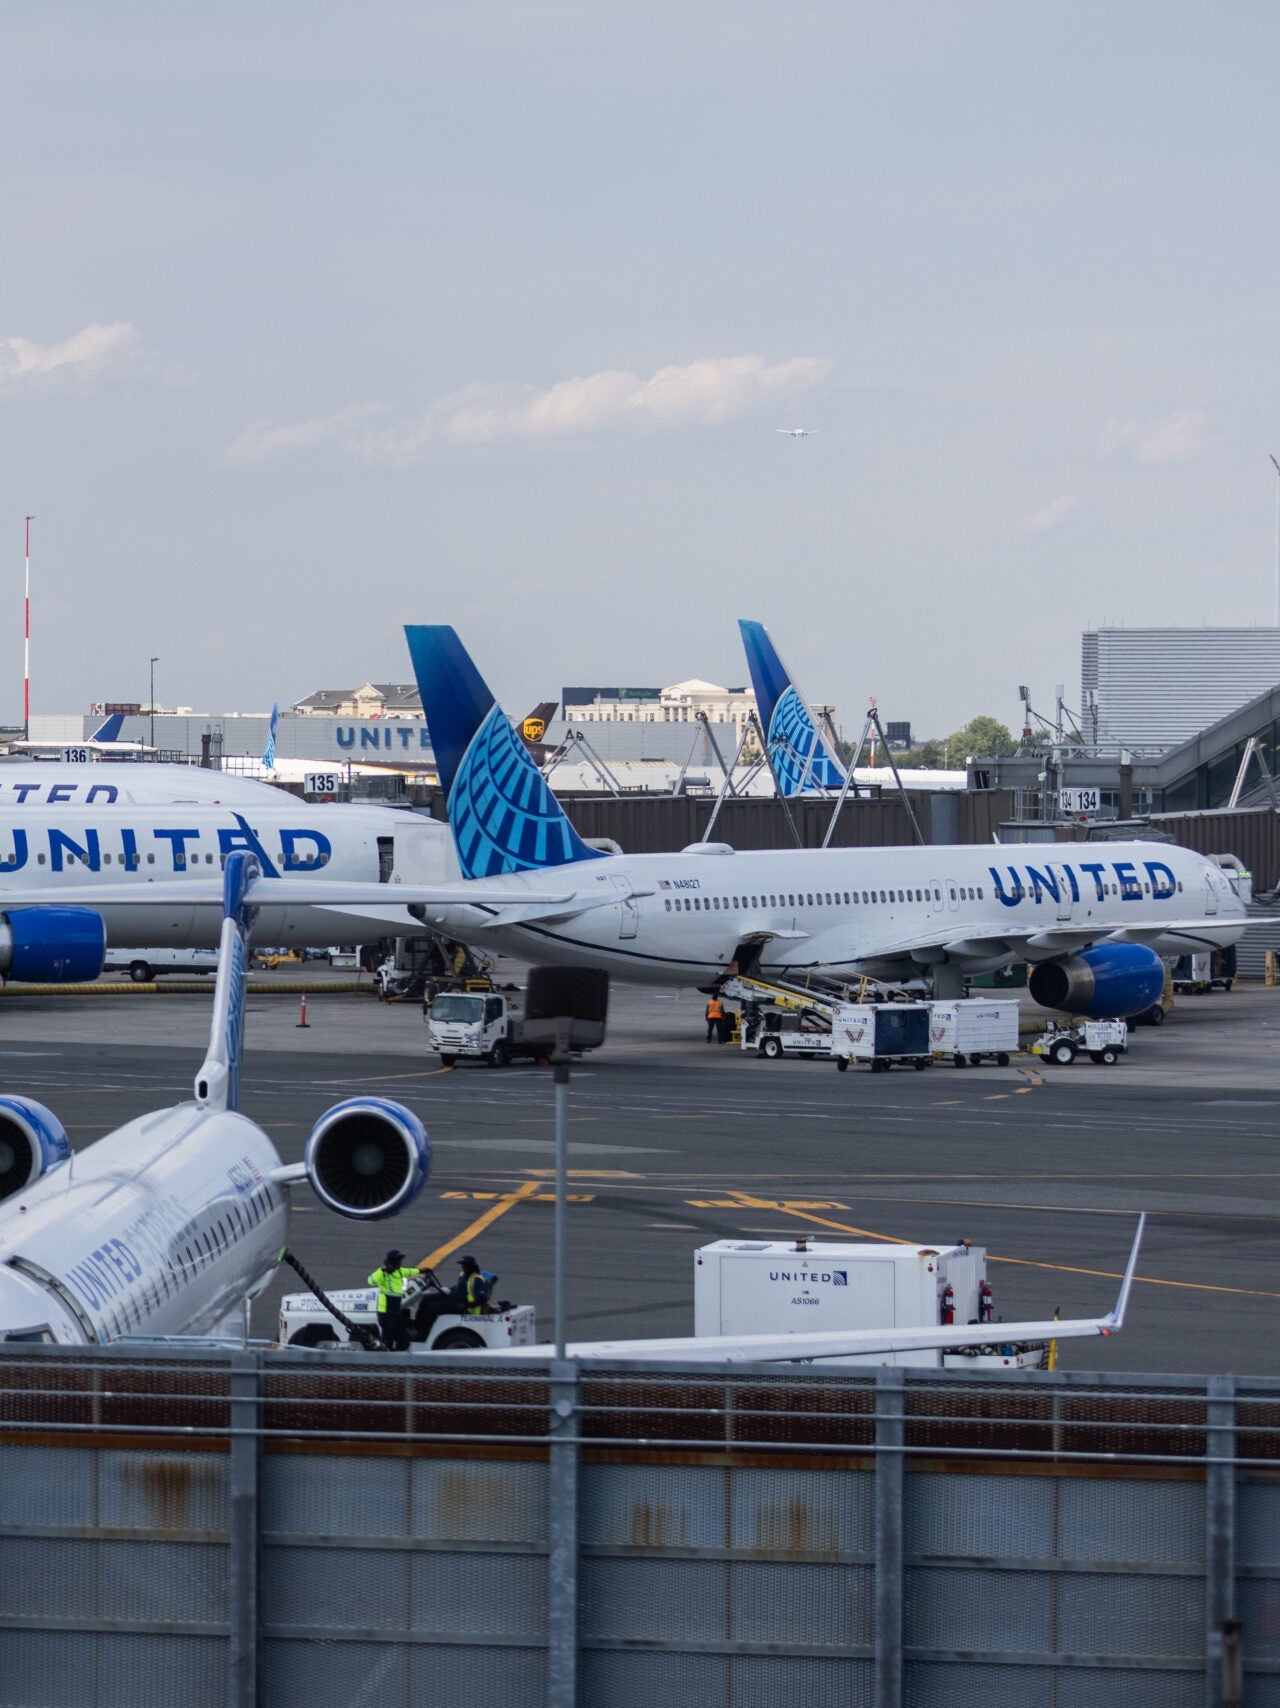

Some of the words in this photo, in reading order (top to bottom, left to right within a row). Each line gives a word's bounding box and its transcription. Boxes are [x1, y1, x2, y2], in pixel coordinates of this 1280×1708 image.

[336, 727, 431, 750] UNITE
[524, 722, 543, 741] ups
[64, 749, 87, 762] 136
[310, 775, 334, 791] 135
[1060, 790, 1071, 809] 134
[1078, 791, 1097, 810] 134
[672, 879, 700, 889] N48127
[988, 861, 1176, 907] UNITED
[66, 1238, 142, 1312] UNITED
[770, 1271, 831, 1282] UNITED
[791, 1297, 820, 1305] AS1066
[461, 1314, 496, 1323] TERMINAL
